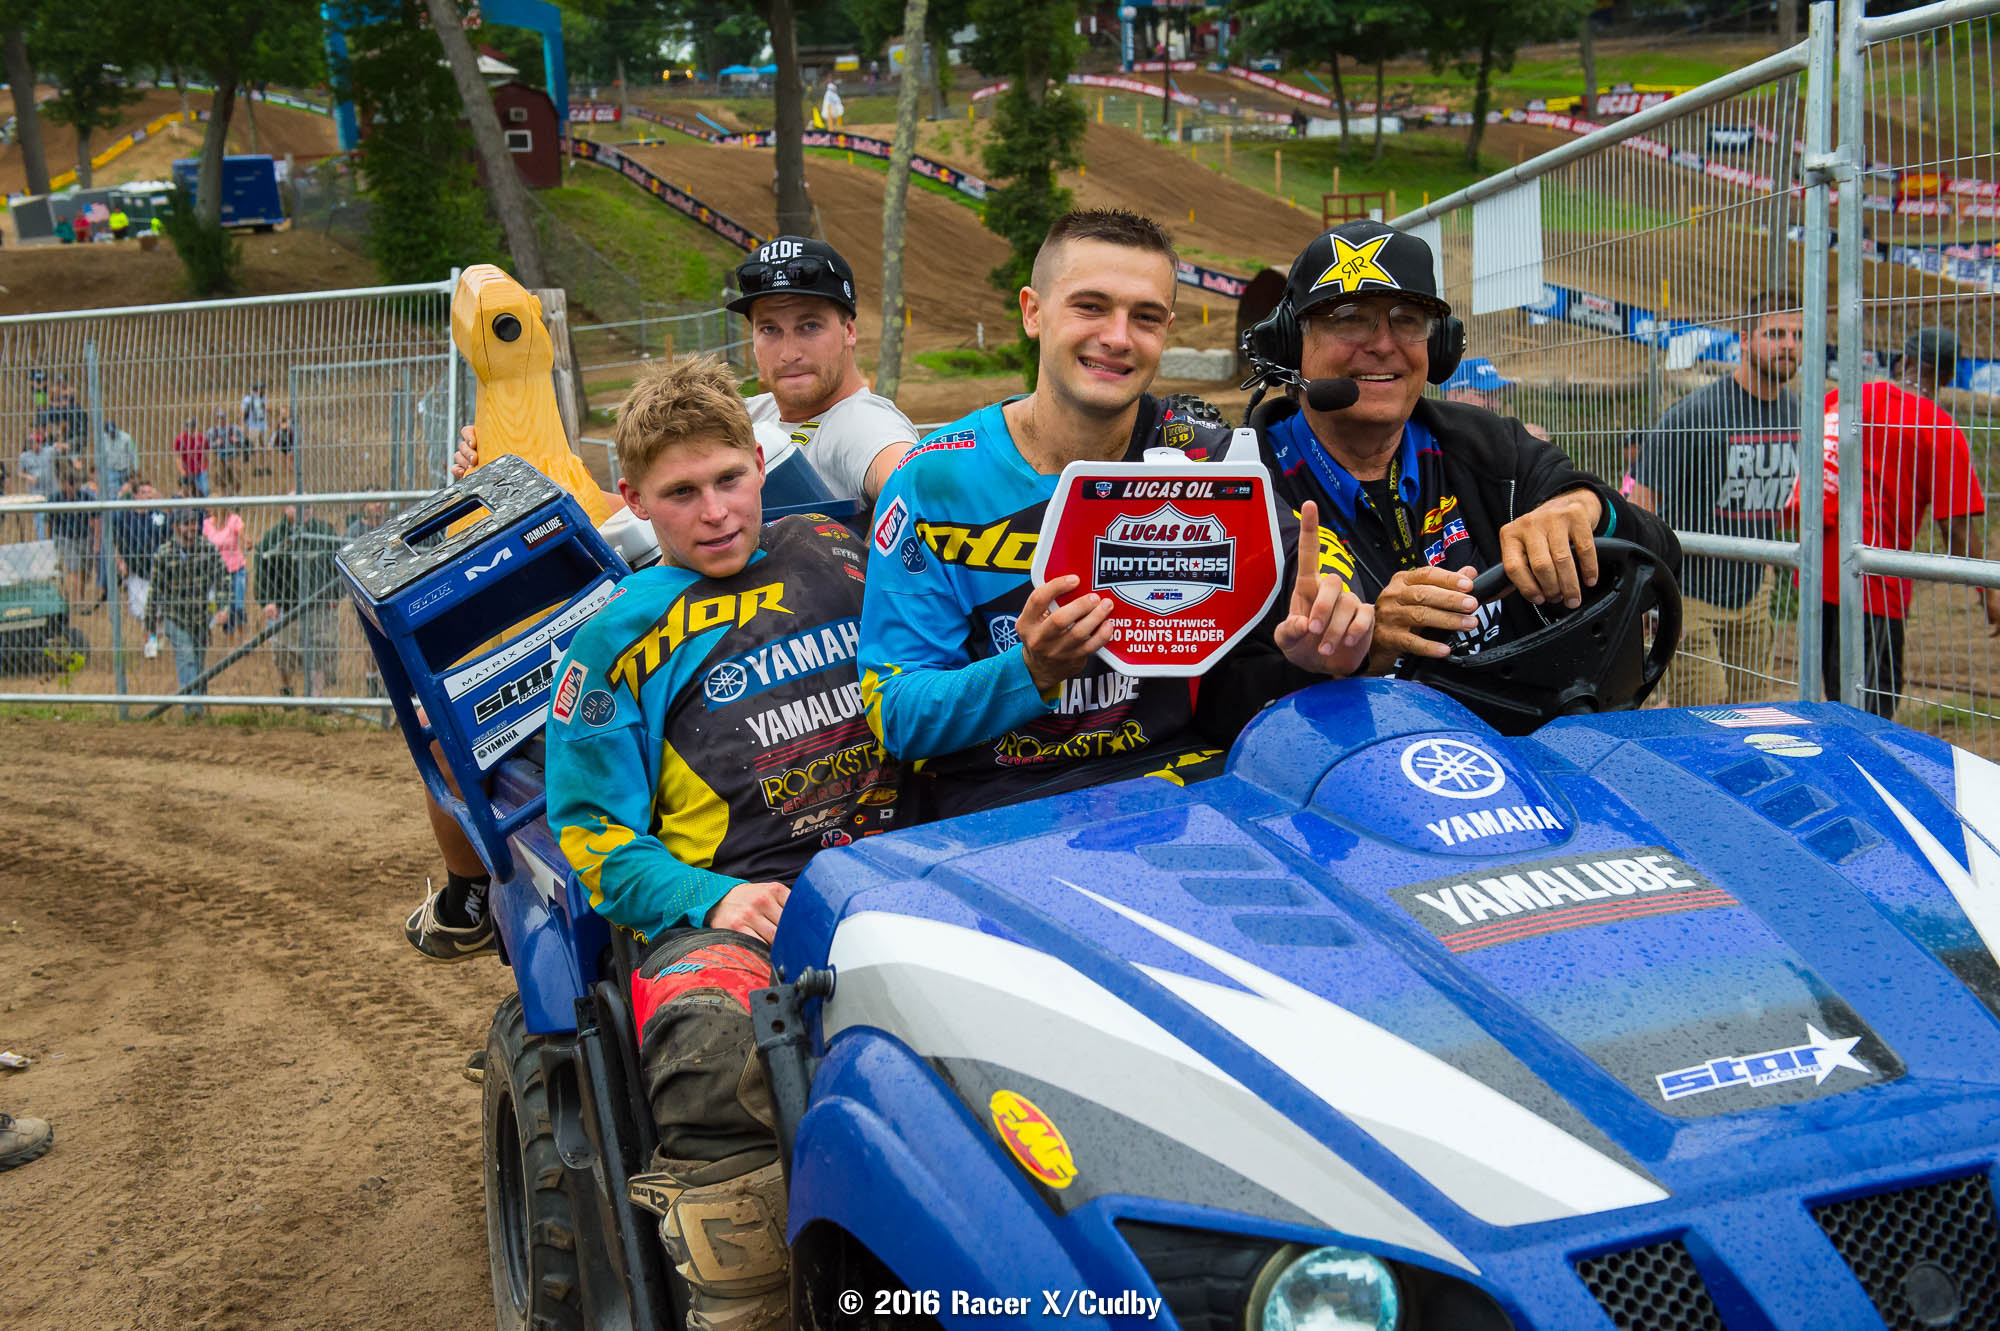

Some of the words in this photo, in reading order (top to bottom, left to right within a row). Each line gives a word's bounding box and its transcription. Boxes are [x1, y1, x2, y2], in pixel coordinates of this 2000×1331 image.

[760, 240, 804, 262] RIDE
[1122, 482, 1182, 498] LUCAS
[1185, 482, 1214, 498] OIL
[523, 515, 564, 545] YAMALUBE
[880, 506, 904, 546] 100%
[1119, 524, 1180, 541] LUCAS
[915, 520, 1041, 570] THO
[1100, 557, 1228, 571] MOTOCROSS
[1125, 629, 1173, 642] POINTS
[1176, 629, 1225, 642] LEADER
[1135, 619, 1146, 627] 7:
[1148, 619, 1216, 628] SOUTHWICK
[461, 651, 517, 687] MATRIX
[523, 595, 606, 649] CONCEPTS
[610, 582, 796, 702] THOR
[745, 621, 862, 686] YAMAH
[1127, 644, 1155, 653] JULY
[1157, 644, 1168, 654] 9,
[1170, 644, 1198, 653] 2016
[557, 667, 583, 717] 100%
[745, 682, 866, 748] YAMALUB
[485, 729, 519, 754] YAMAHA
[1425, 806, 1564, 846] YAMAHA
[1752, 1065, 1823, 1084] RACING
[989, 1094, 1078, 1180] FMF
